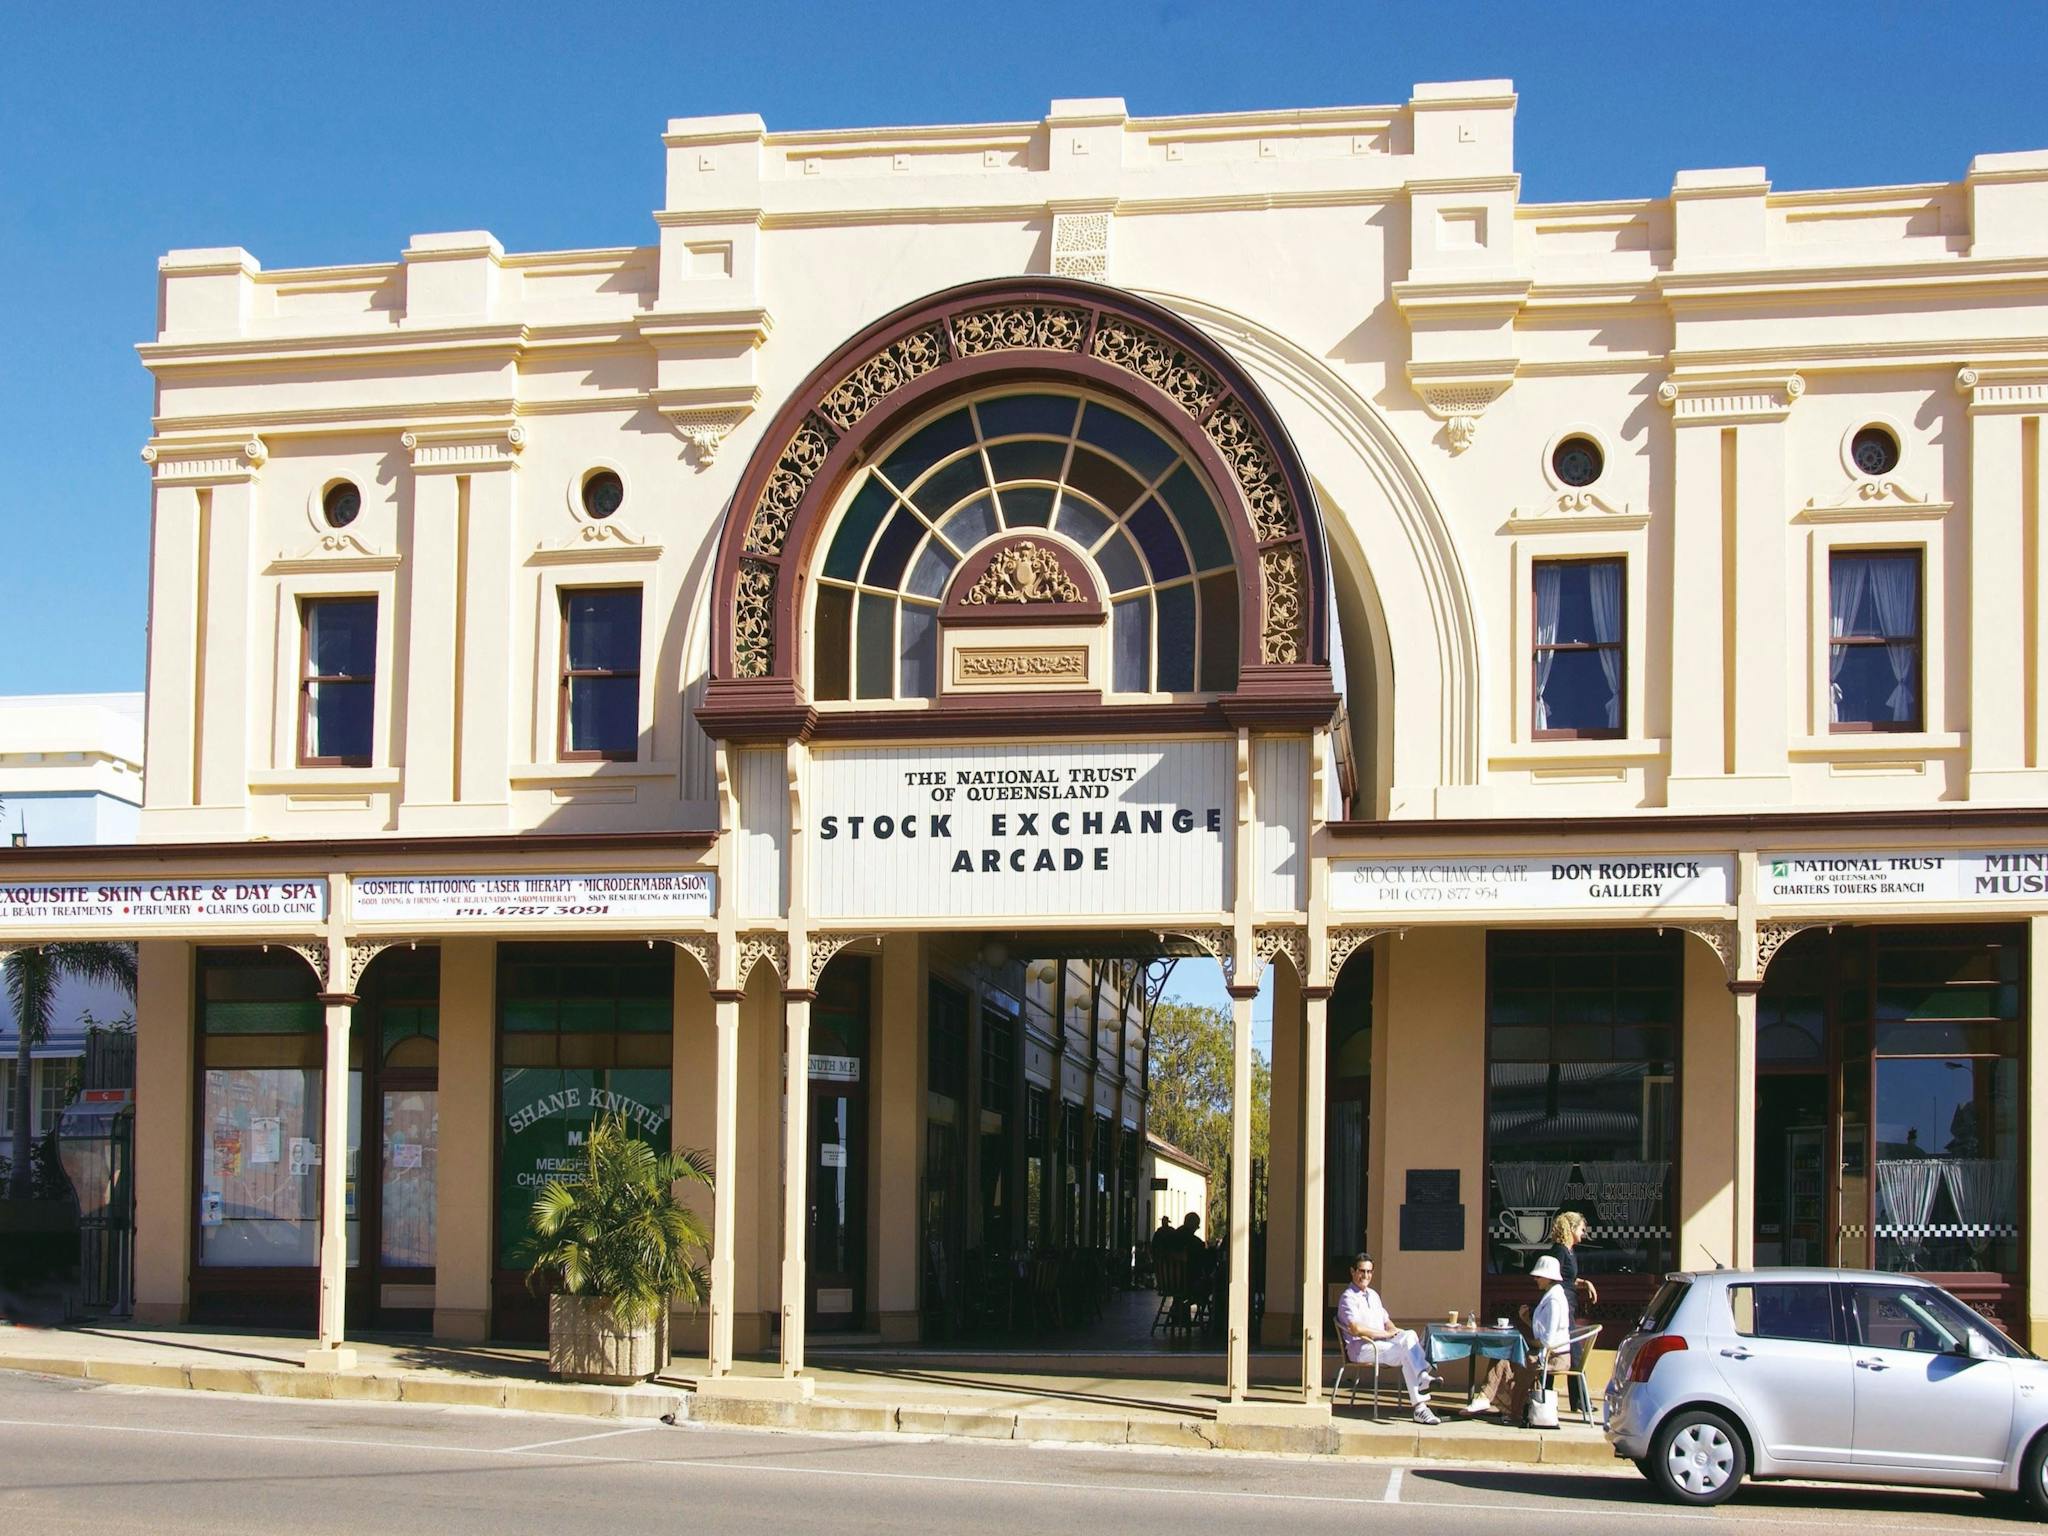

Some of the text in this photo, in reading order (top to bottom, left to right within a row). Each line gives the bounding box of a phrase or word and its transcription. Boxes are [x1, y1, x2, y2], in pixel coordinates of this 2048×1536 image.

[904, 767, 1137, 786] THE NATIONAL TRUST
[931, 785, 1110, 803] OF QUEENSLAND
[820, 808, 1222, 841] STOCK EXCHANGE
[951, 847, 1109, 873] ARCADE
[1794, 857, 1945, 872] NATIONAL TRUST
[1984, 853, 2048, 872] MIN
[1354, 864, 1528, 883] STOCK EXCHANGE CAFE
[1551, 862, 1700, 880] DON RODERICK
[1814, 873, 1888, 882] OF QUEENSLAND
[97, 885, 142, 902] SKIN
[150, 885, 203, 901] CARE
[211, 885, 228, 901] &
[235, 883, 273, 900] DAY
[281, 883, 317, 900] SPA
[363, 876, 707, 895] COSMETIC TATTOOING LASER THERAPY MICRODERMABRASION
[1588, 884, 1663, 898] GALLERY
[1773, 882, 1925, 895] CHARTERS TOWERS BRANCH
[1975, 875, 2048, 894] MUS
[12, 906, 48, 917] BEAUTY
[52, 906, 113, 916] TREATMENTS
[133, 904, 192, 915] PERFUMERY
[206, 903, 249, 915] CLARINS
[252, 903, 280, 914] GOLD
[283, 902, 316, 913] CLINIC
[492, 905, 549, 916] 4787
[553, 905, 609, 915] 3091
[808, 1058, 836, 1072] NUTH
[508, 1087, 664, 1135] SHANE KNUTH
